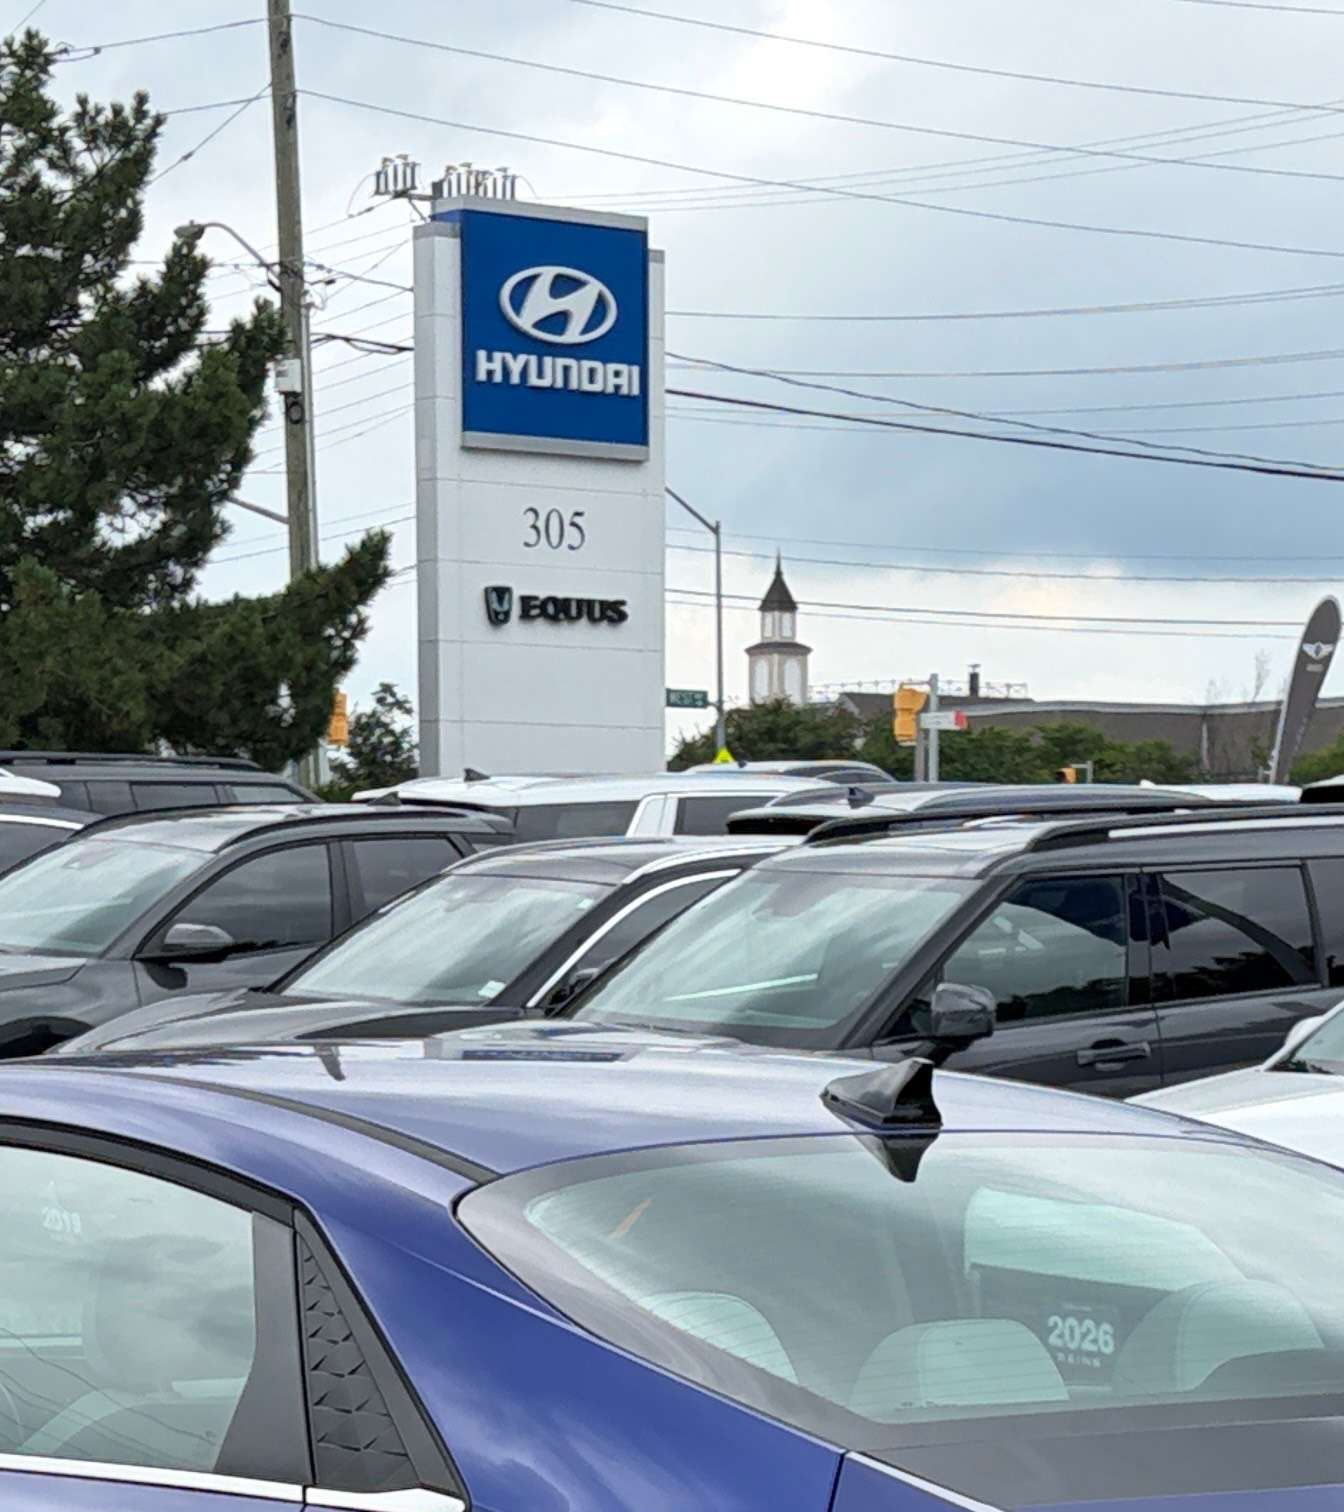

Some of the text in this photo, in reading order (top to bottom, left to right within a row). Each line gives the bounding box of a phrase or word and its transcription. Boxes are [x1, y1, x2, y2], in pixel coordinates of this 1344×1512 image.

[474, 348, 641, 397] HYUNDAI
[522, 507, 587, 551] 305
[517, 594, 629, 626] EQUUS
[1047, 1314, 1116, 1356] 2026
